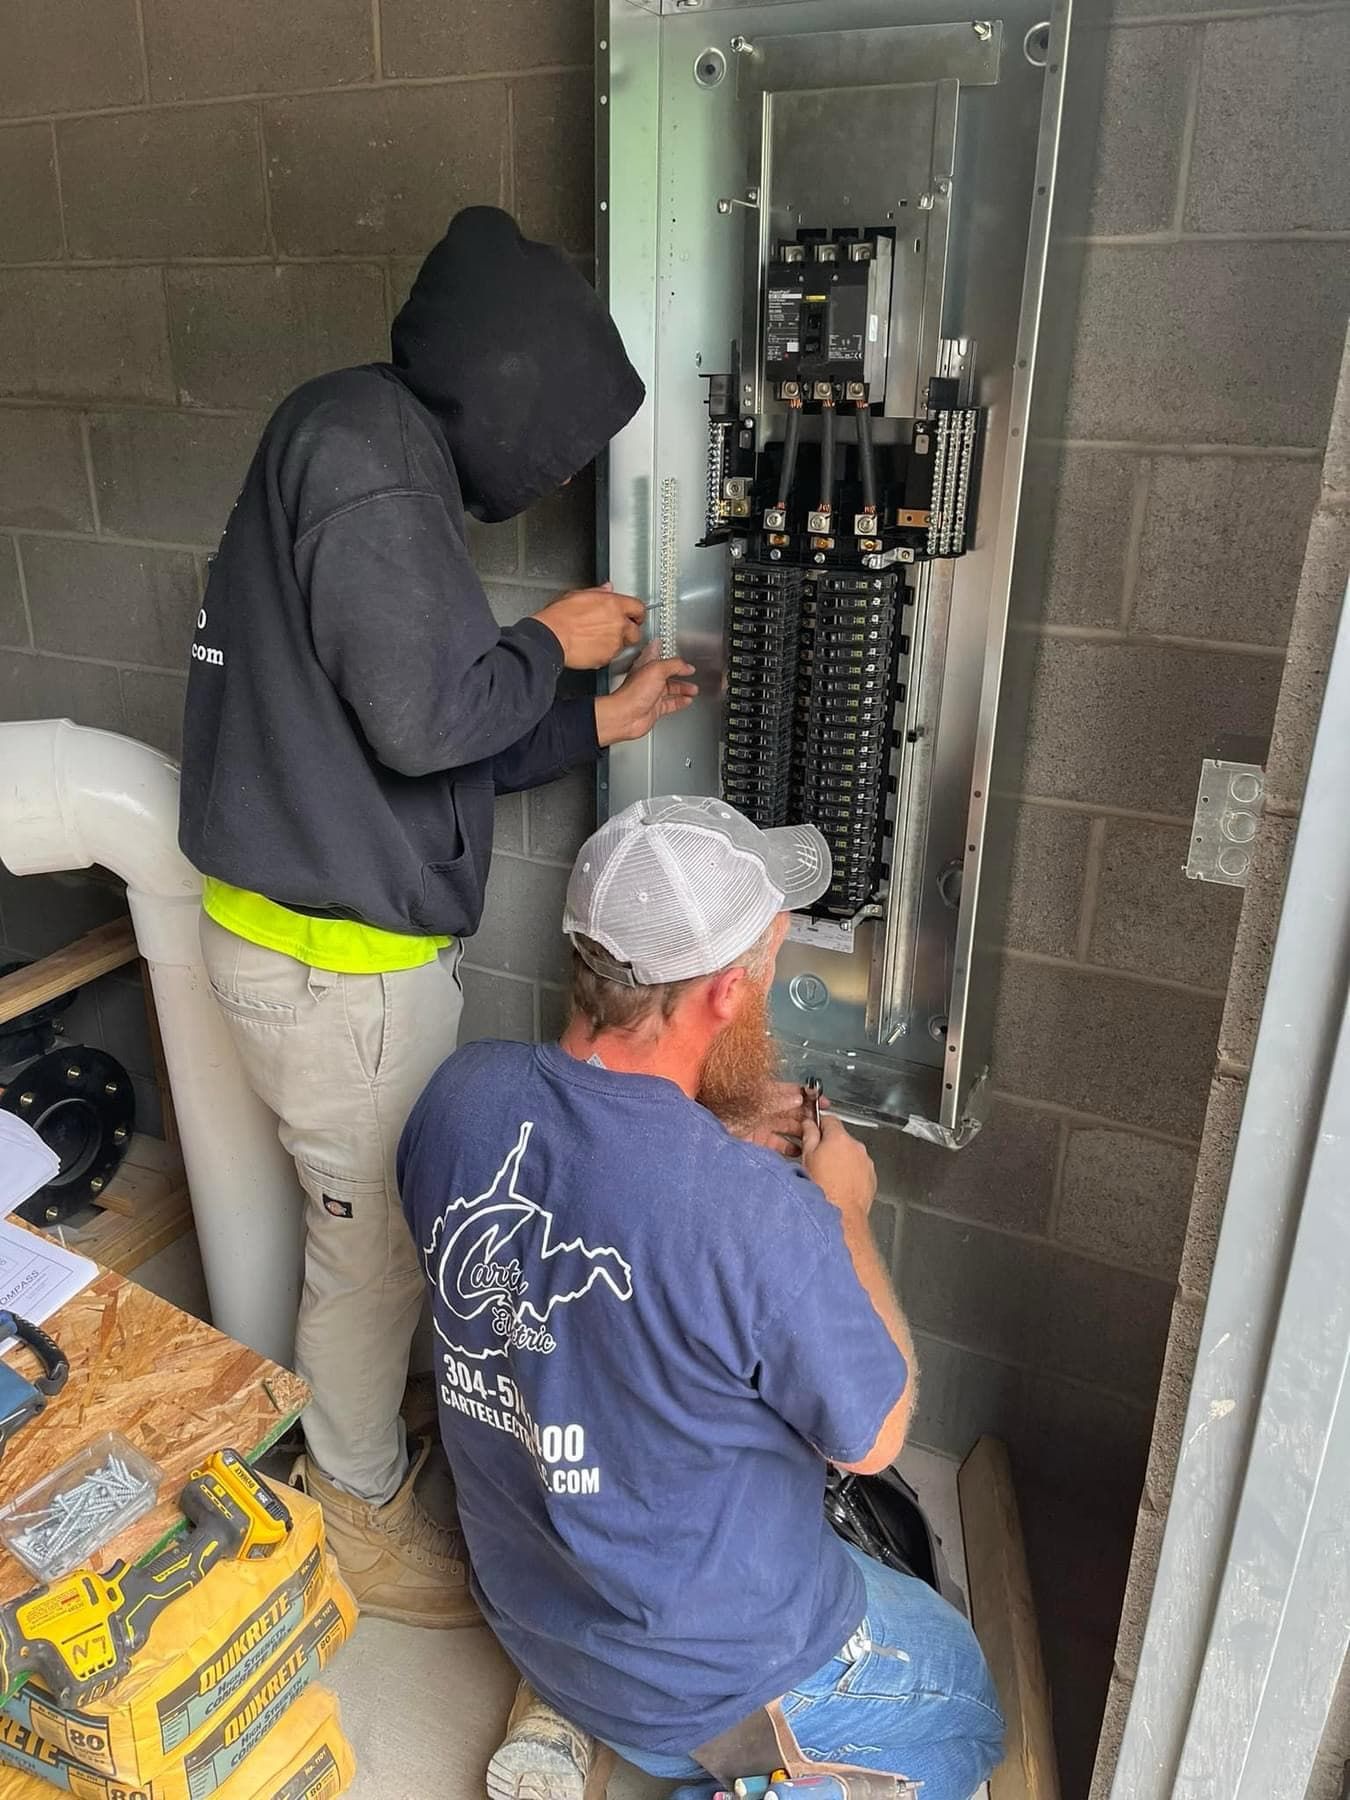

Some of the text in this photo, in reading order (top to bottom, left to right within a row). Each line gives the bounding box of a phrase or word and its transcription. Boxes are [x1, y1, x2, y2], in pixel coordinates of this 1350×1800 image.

[200, 1591, 292, 1696] QUIKRETE
[224, 1644, 308, 1749] QUIKRETE
[69, 1727, 105, 1751] 80
[310, 1781, 322, 1797] 80
